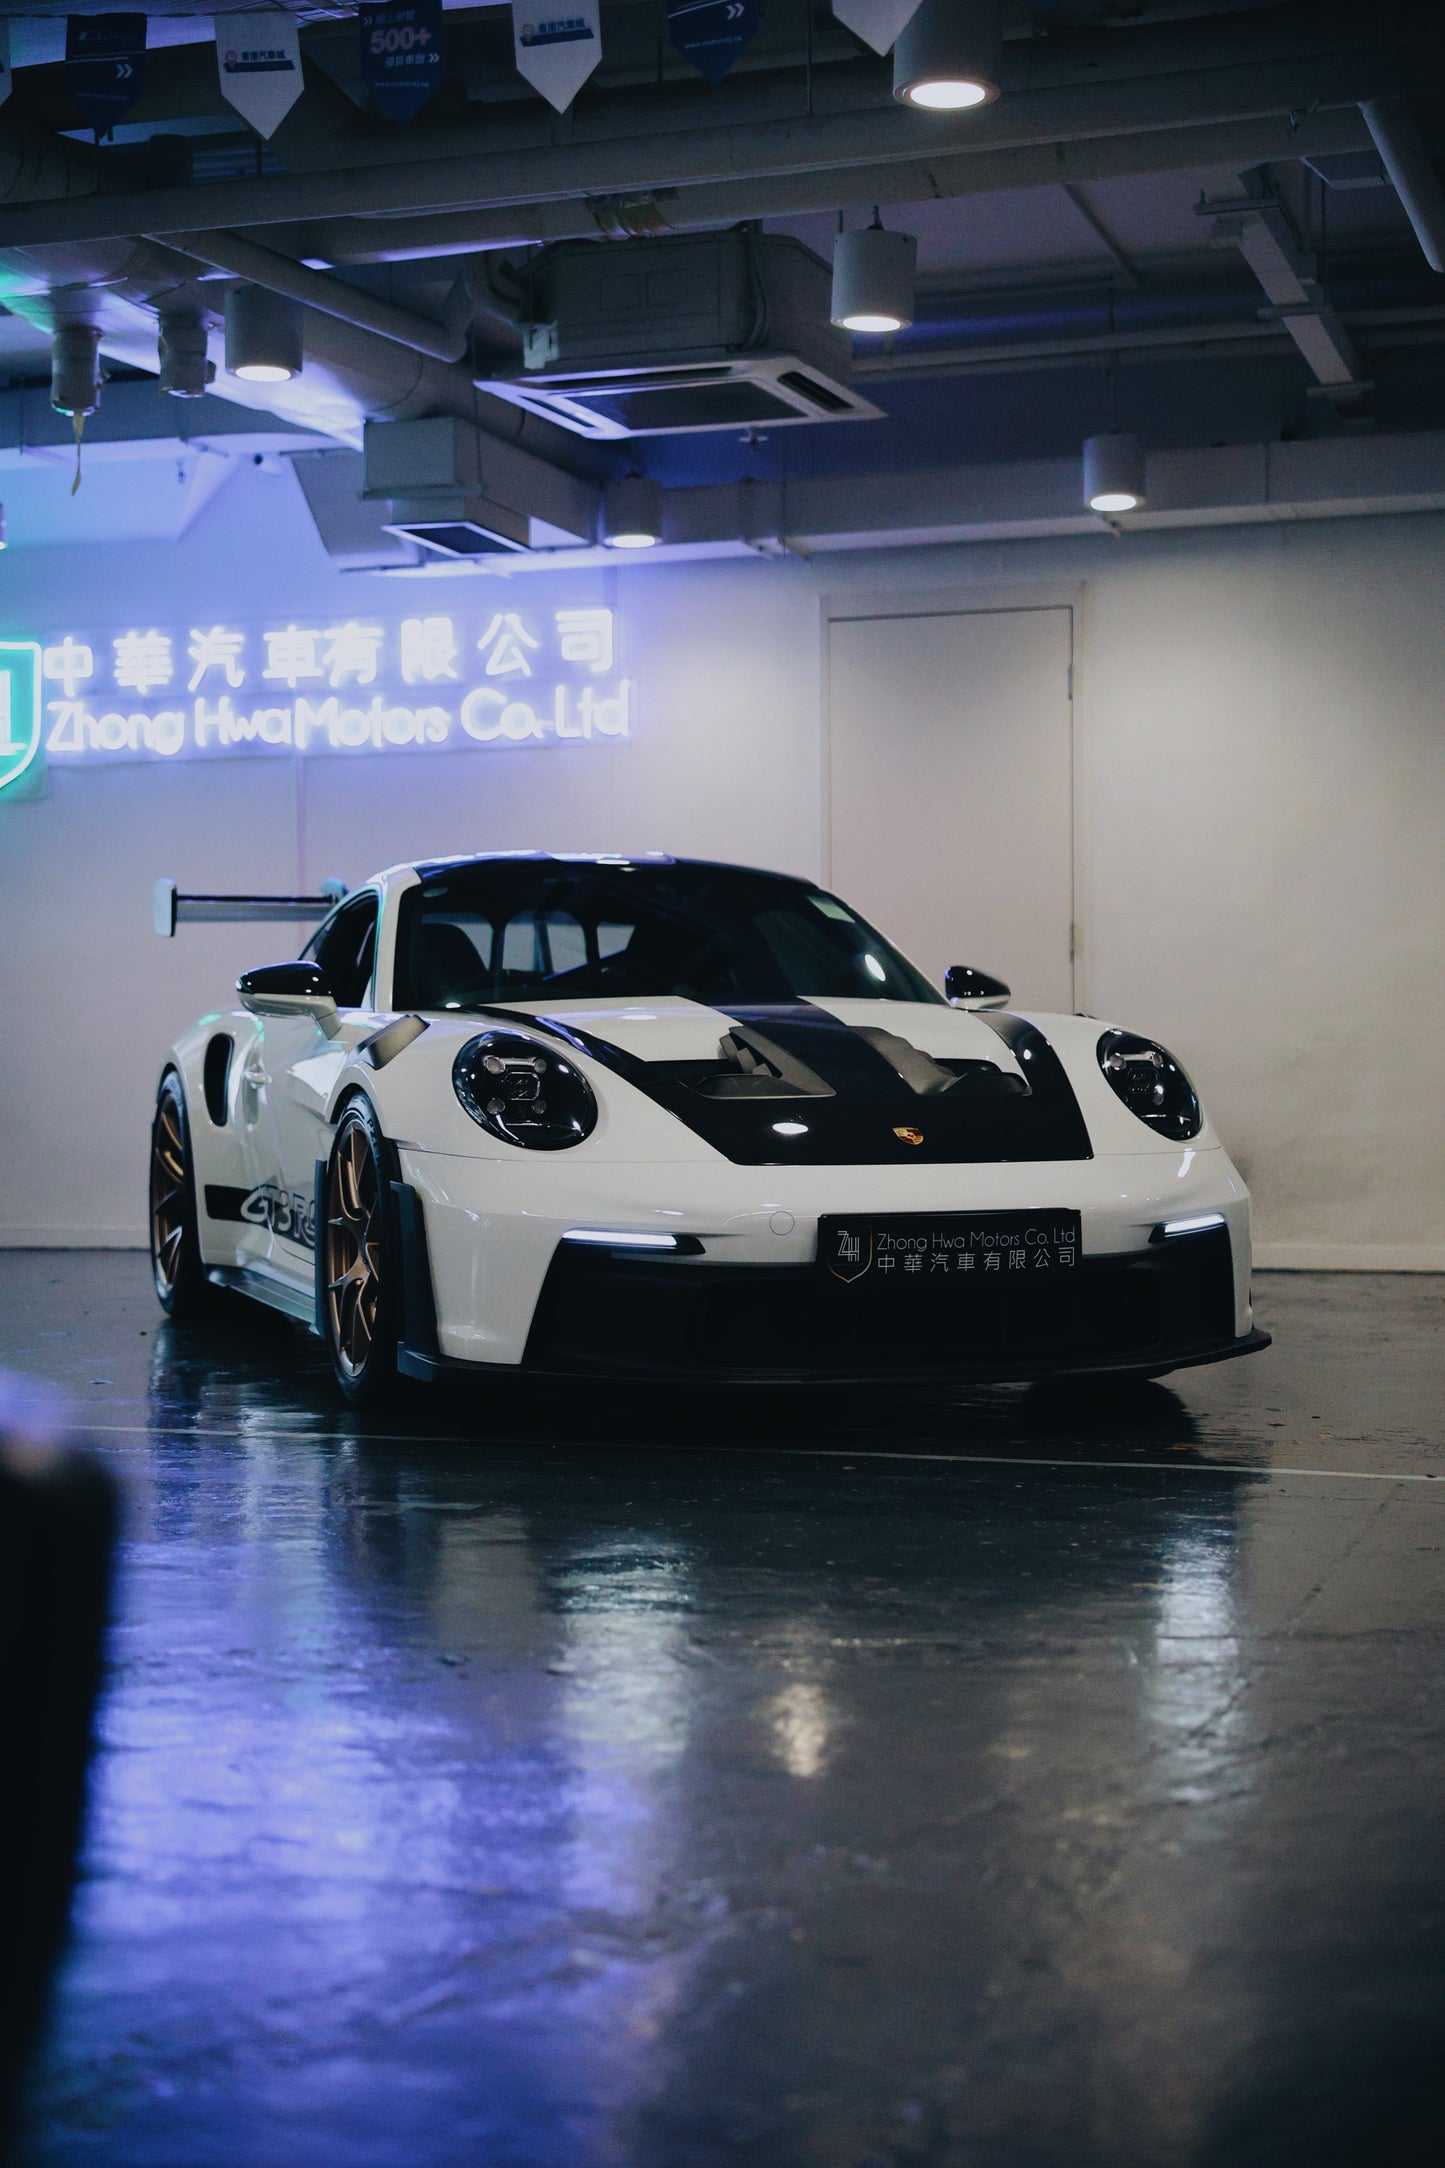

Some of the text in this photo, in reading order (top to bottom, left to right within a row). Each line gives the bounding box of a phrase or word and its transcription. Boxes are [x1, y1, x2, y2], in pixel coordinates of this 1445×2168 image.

[370, 27, 432, 54] 500+
[43, 608, 616, 695] 中華汽車有限公司
[46, 699, 185, 756] Zhong
[195, 696, 292, 747] Hwa
[295, 696, 451, 748] Motors
[555, 678, 630, 739] Ltd
[877, 1226, 1075, 1252] Zhong Hwa Motors Co. Ltd
[877, 1246, 1076, 1275] 中華汽車有限公司
